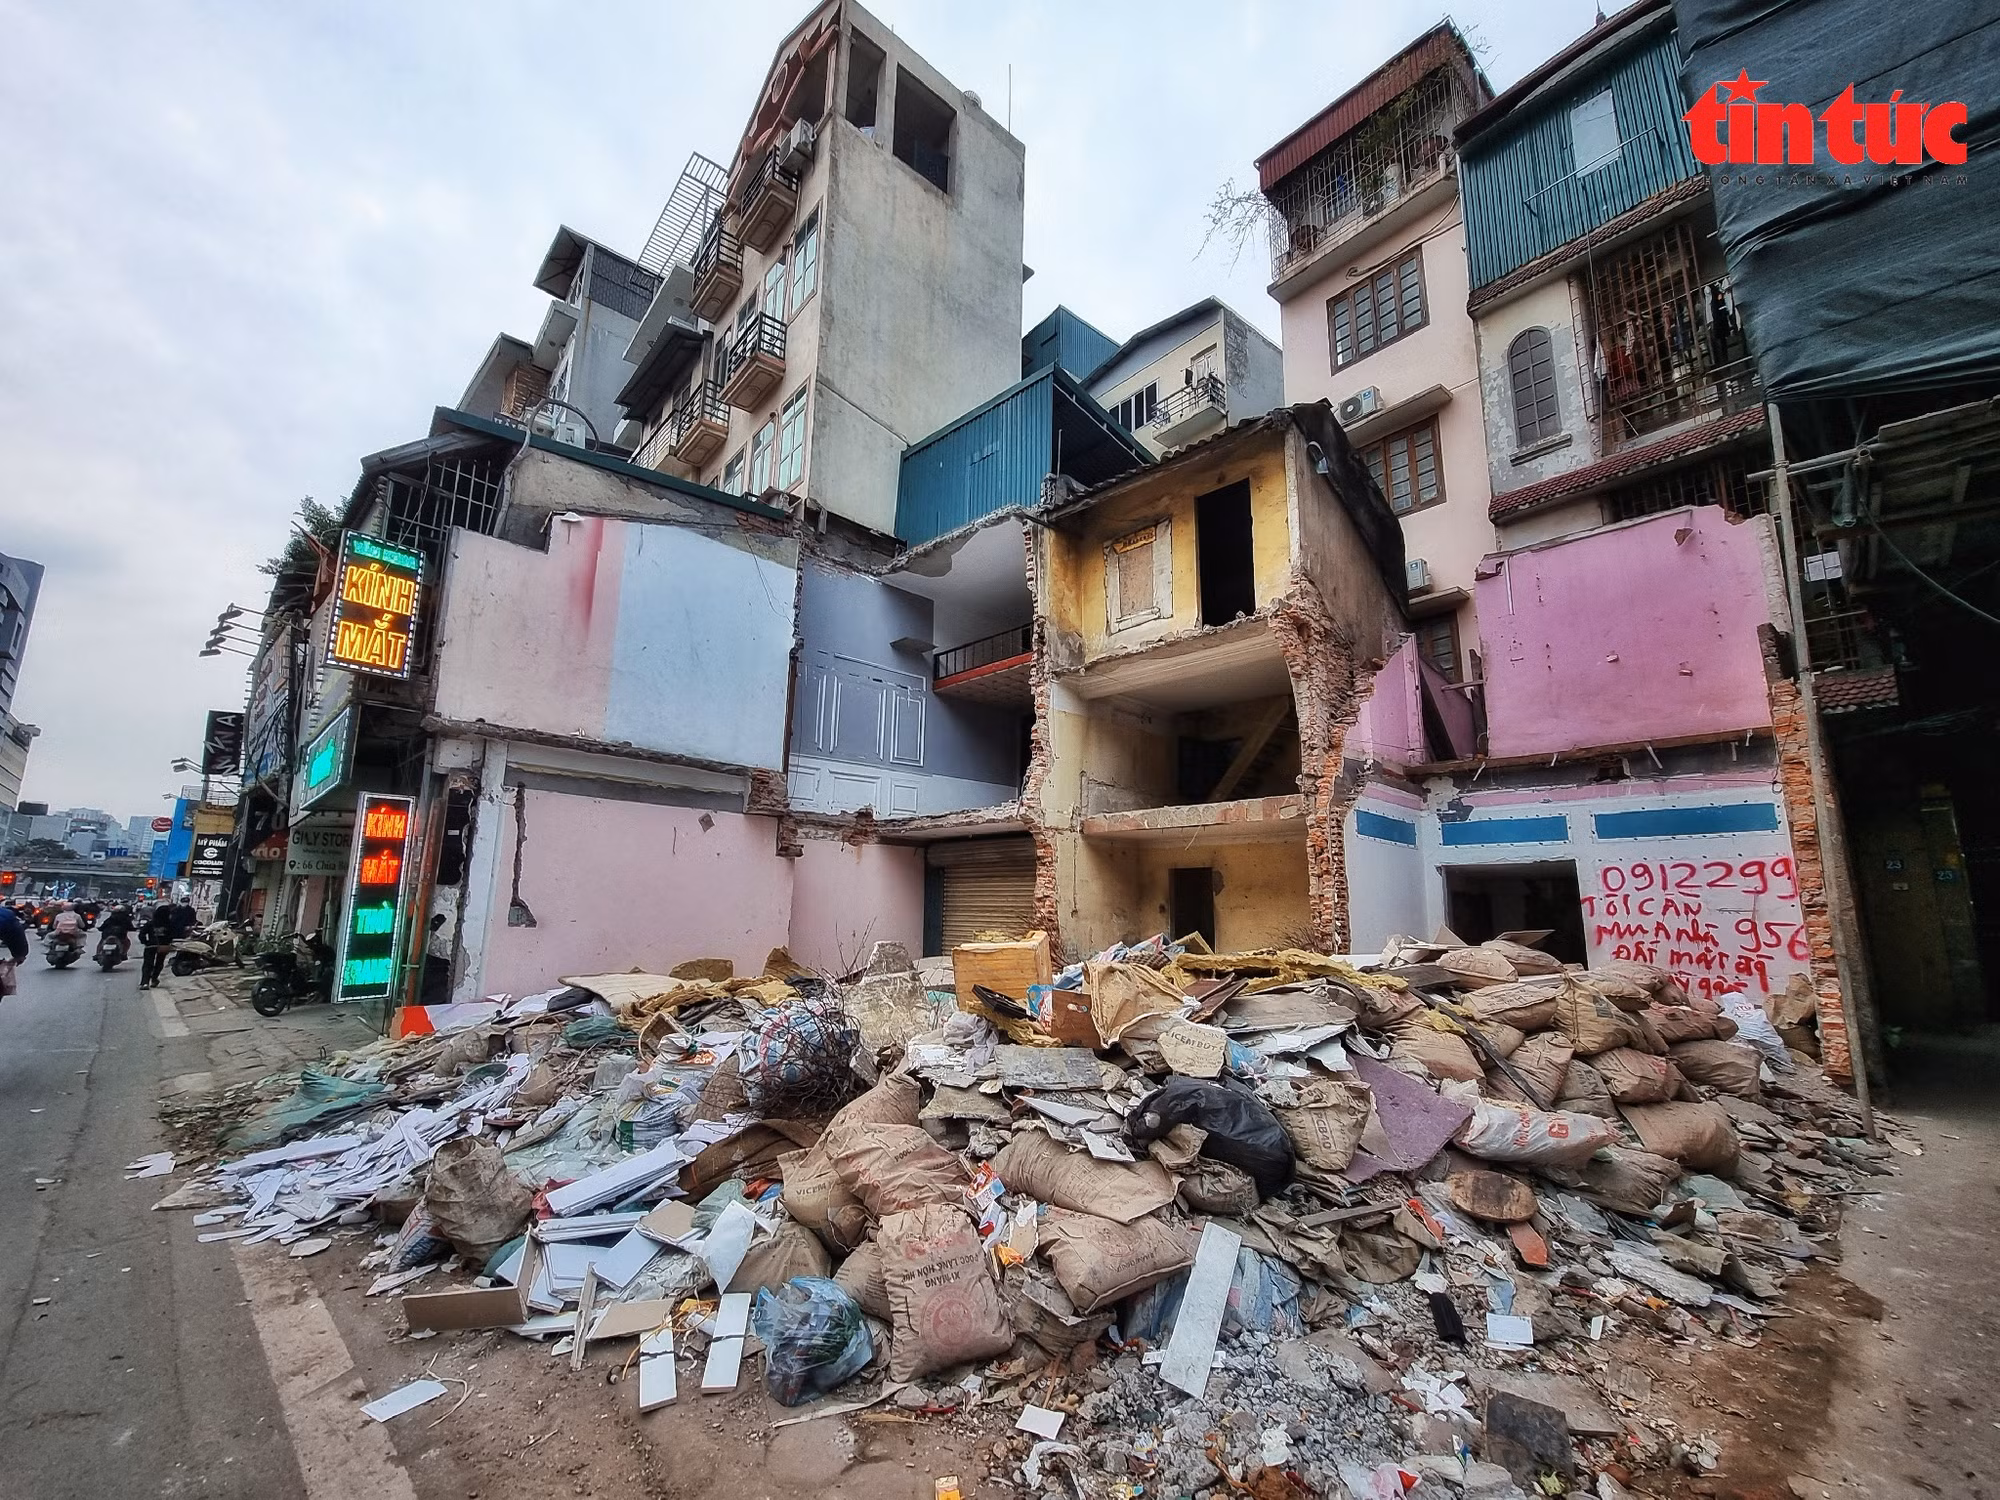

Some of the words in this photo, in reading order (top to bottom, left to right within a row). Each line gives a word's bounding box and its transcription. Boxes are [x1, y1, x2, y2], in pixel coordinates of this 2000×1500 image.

[343, 563, 415, 616] KÍNH
[336, 613, 407, 669] MẮT
[321, 831, 353, 848] STOR
[365, 807, 406, 838] KÍNH
[361, 850, 399, 884] MẮT
[1601, 855, 1799, 900] 0912299
[796, 1182, 827, 1195] VICEM
